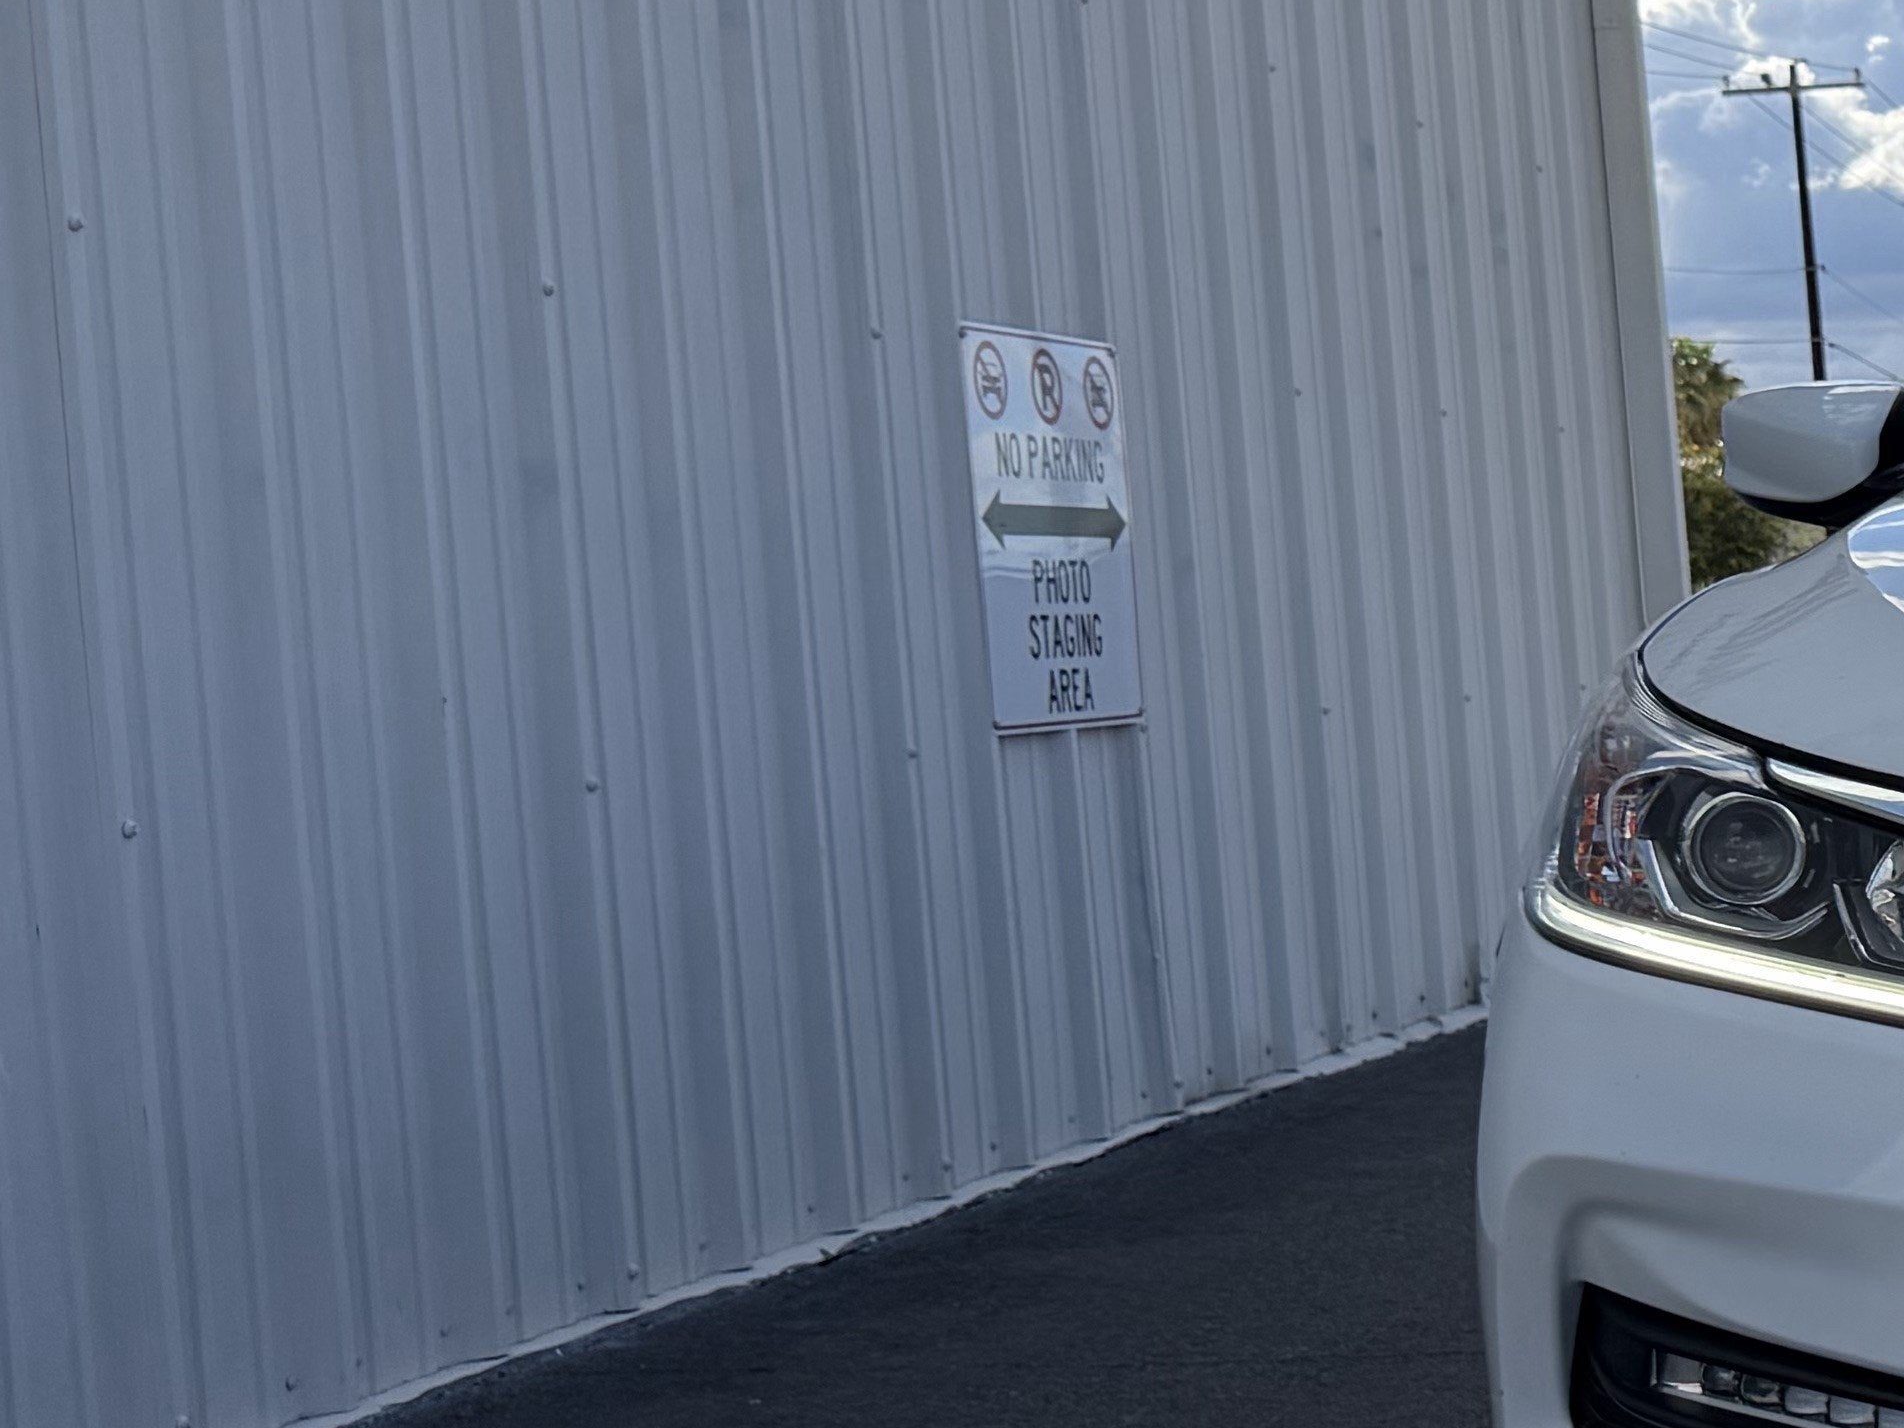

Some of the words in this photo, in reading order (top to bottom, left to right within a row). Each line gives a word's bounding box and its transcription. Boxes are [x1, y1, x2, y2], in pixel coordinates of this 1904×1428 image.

[995, 432, 1021, 478] NO
[1027, 433, 1105, 483] PARKING
[1033, 560, 1091, 603] PHOTO
[1029, 613, 1103, 659] STAGING
[1049, 668, 1095, 714] AREA
